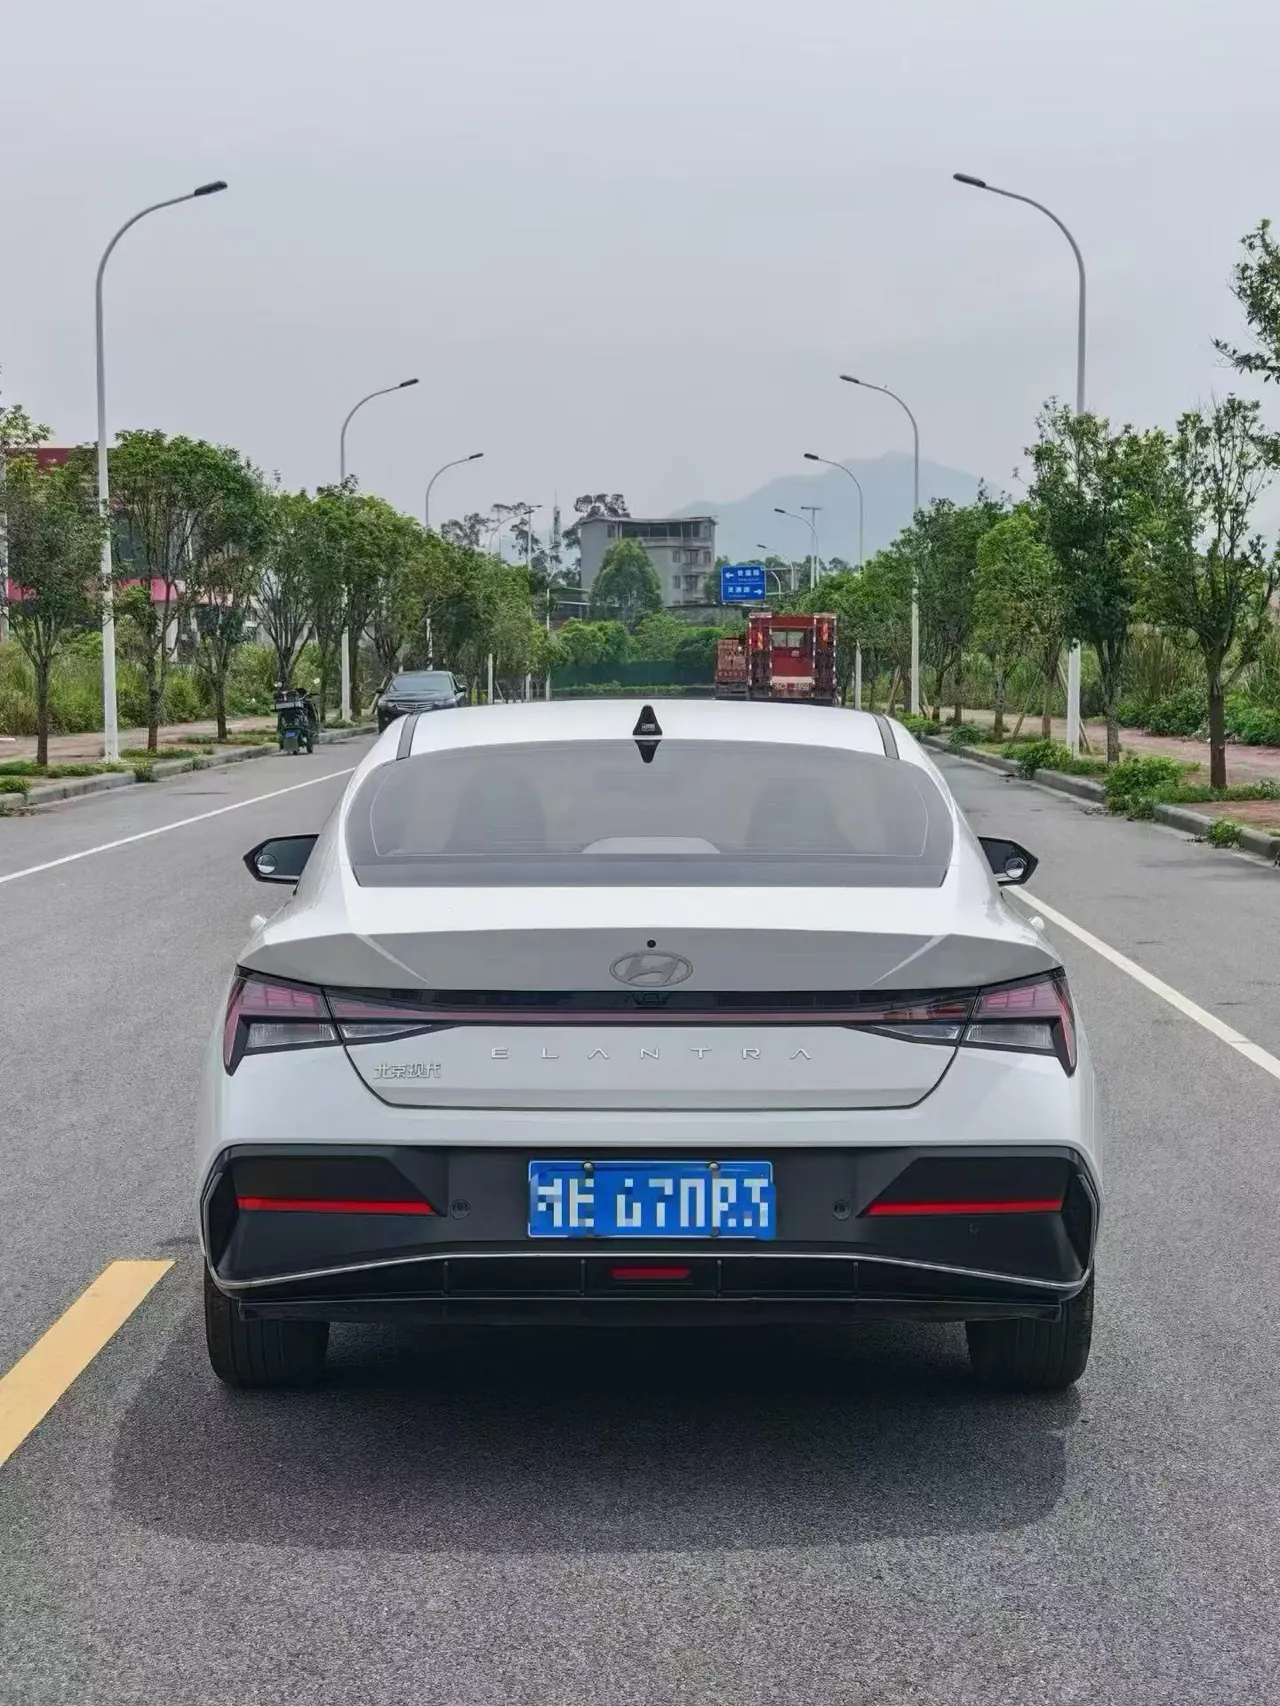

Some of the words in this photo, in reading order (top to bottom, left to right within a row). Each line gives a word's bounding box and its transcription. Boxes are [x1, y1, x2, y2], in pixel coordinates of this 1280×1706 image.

[491, 1047, 812, 1059] ELANTRA
[374, 1062, 441, 1079] 北京现代
